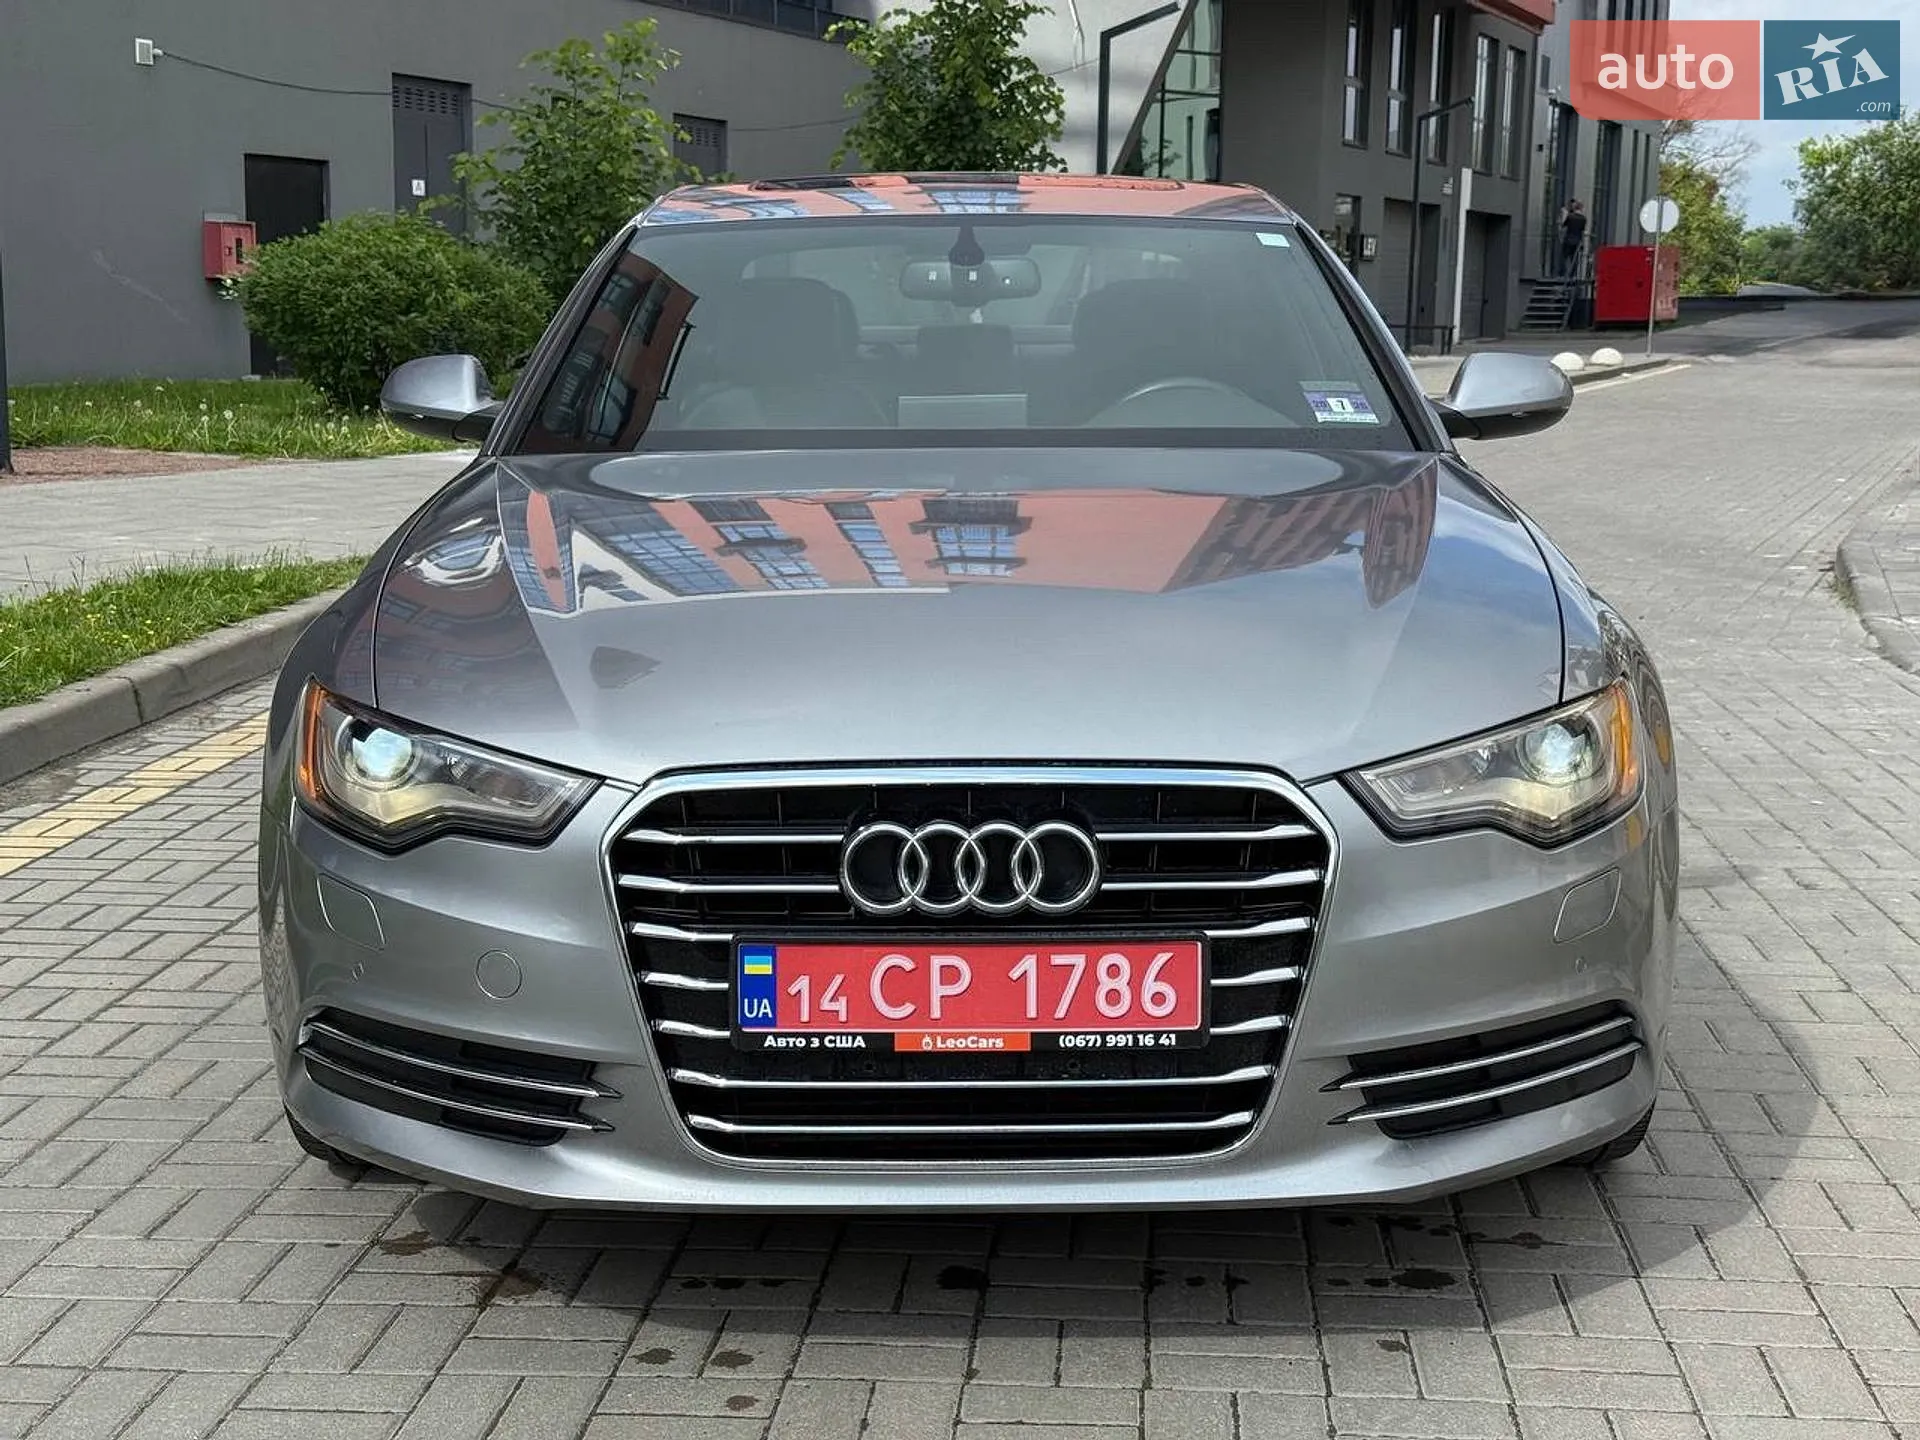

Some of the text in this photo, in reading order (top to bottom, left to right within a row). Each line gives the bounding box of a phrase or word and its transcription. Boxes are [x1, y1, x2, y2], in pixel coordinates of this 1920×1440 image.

[787, 952, 1178, 1023] 14 CP 1786
[743, 998, 773, 1018] UA
[824, 1035, 866, 1048] США
[936, 1035, 1004, 1049] LeoCars
[1059, 1033, 1176, 1048] (067) 991 16 41
